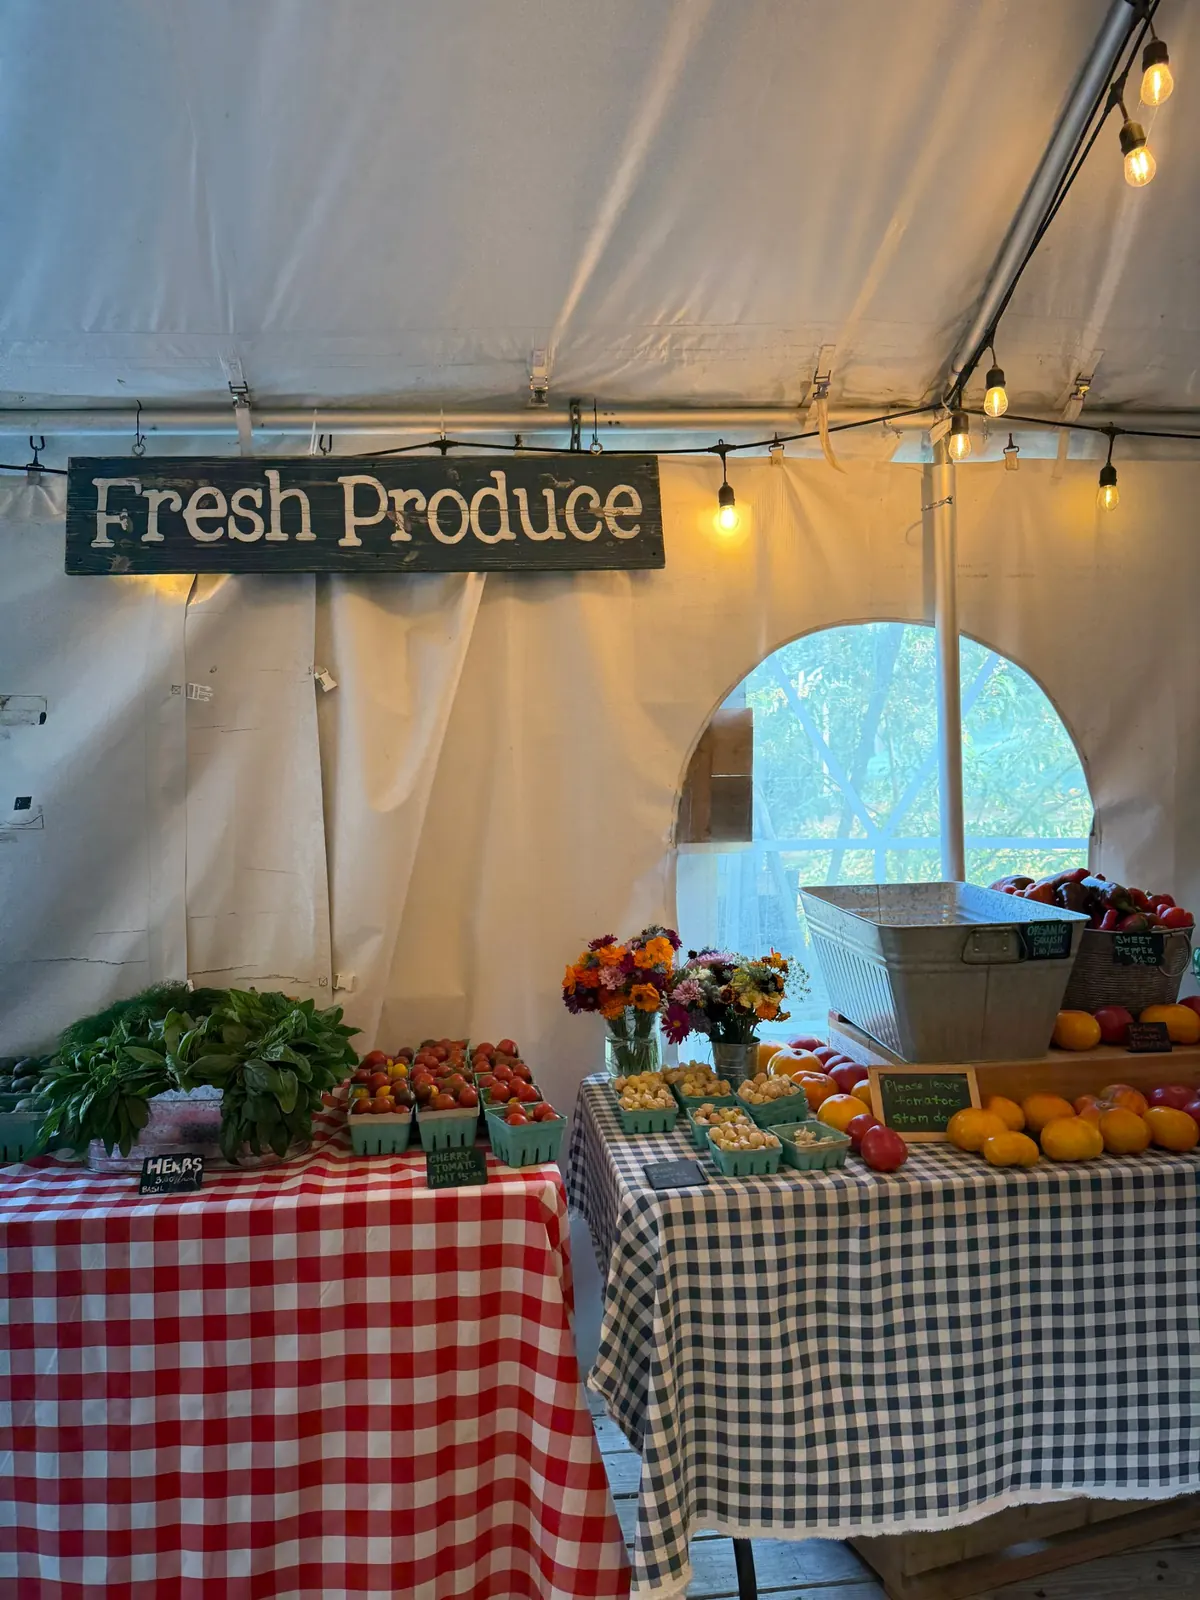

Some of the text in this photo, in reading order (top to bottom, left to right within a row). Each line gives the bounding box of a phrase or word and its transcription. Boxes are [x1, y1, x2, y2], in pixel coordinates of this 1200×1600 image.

[90, 469, 643, 549] Fresh Produce
[1115, 936, 1152, 944] SWEET
[1115, 946, 1154, 956] PEPPER
[884, 1079, 960, 1093] Please leave
[896, 1094, 961, 1107] tomatoes
[429, 1151, 471, 1163] CHERRY
[146, 1157, 203, 1174] HERBS
[141, 1185, 165, 1193] BASIL
